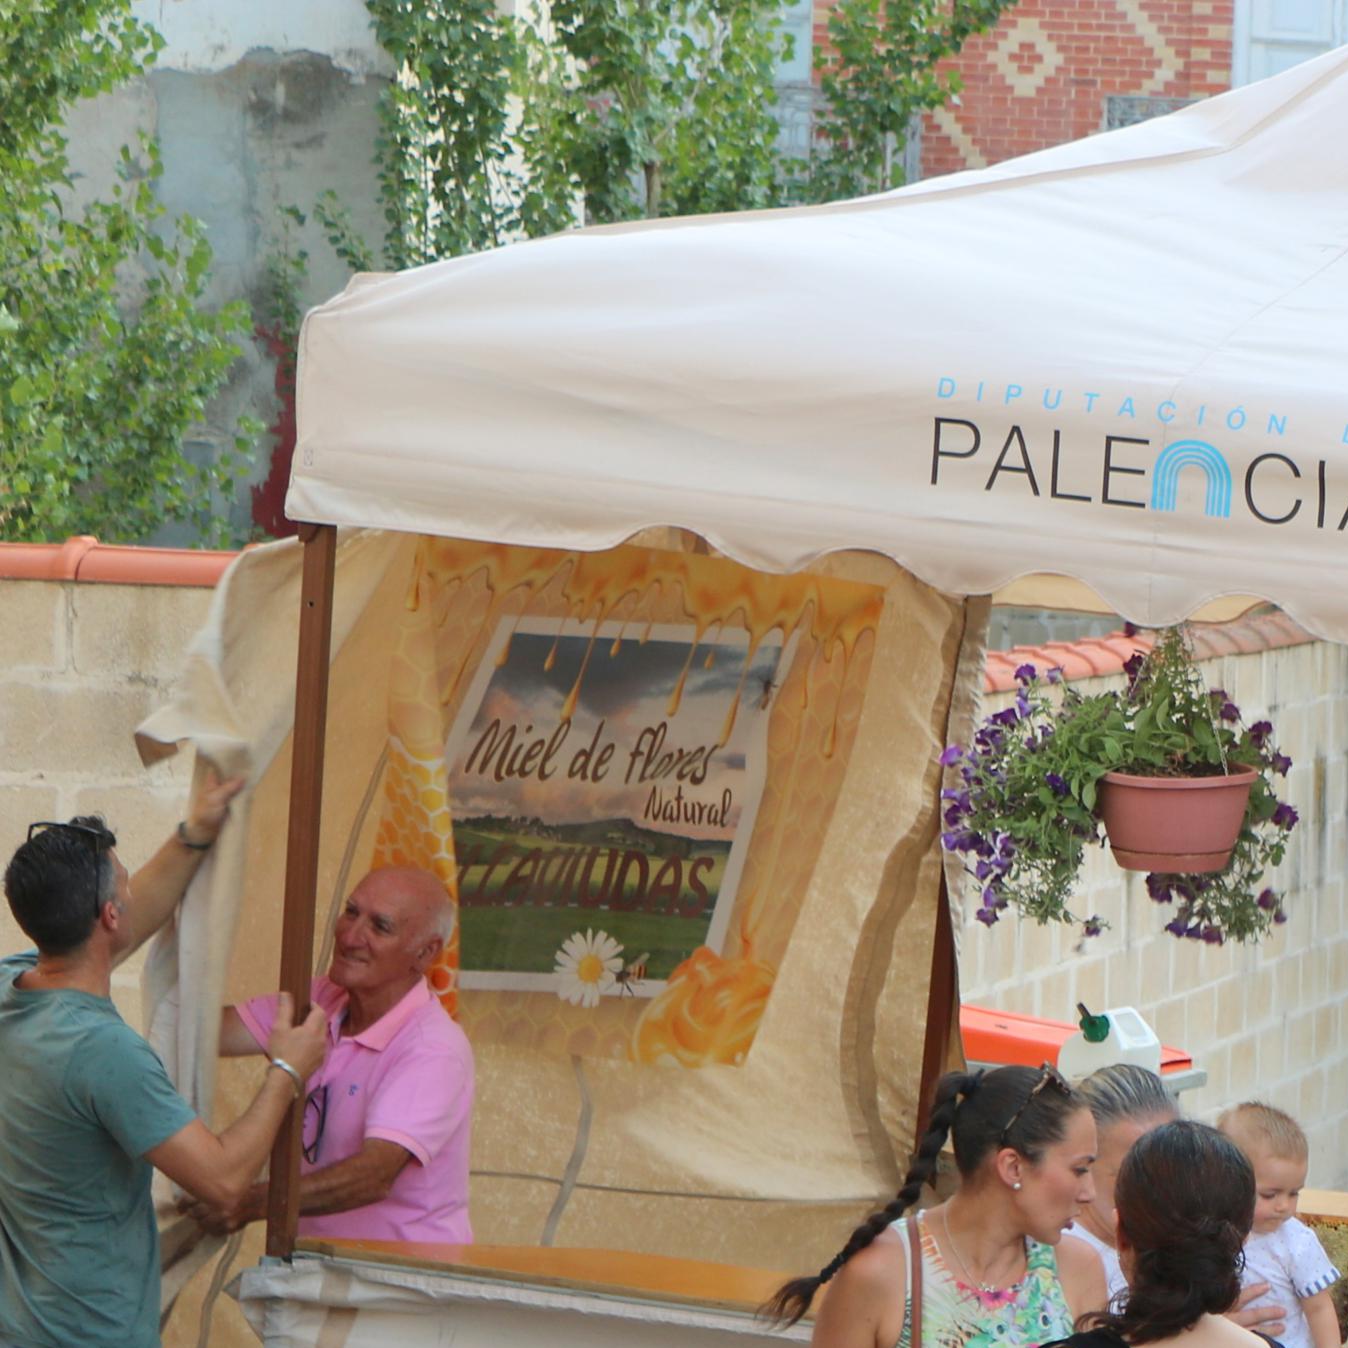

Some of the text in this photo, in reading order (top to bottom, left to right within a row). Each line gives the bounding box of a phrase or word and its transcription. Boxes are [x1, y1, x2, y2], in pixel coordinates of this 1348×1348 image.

[936, 376, 1288, 437] DIPUTACIÓN
[465, 718, 570, 785] Miel
[566, 718, 616, 785] de
[643, 785, 733, 828] Natural
